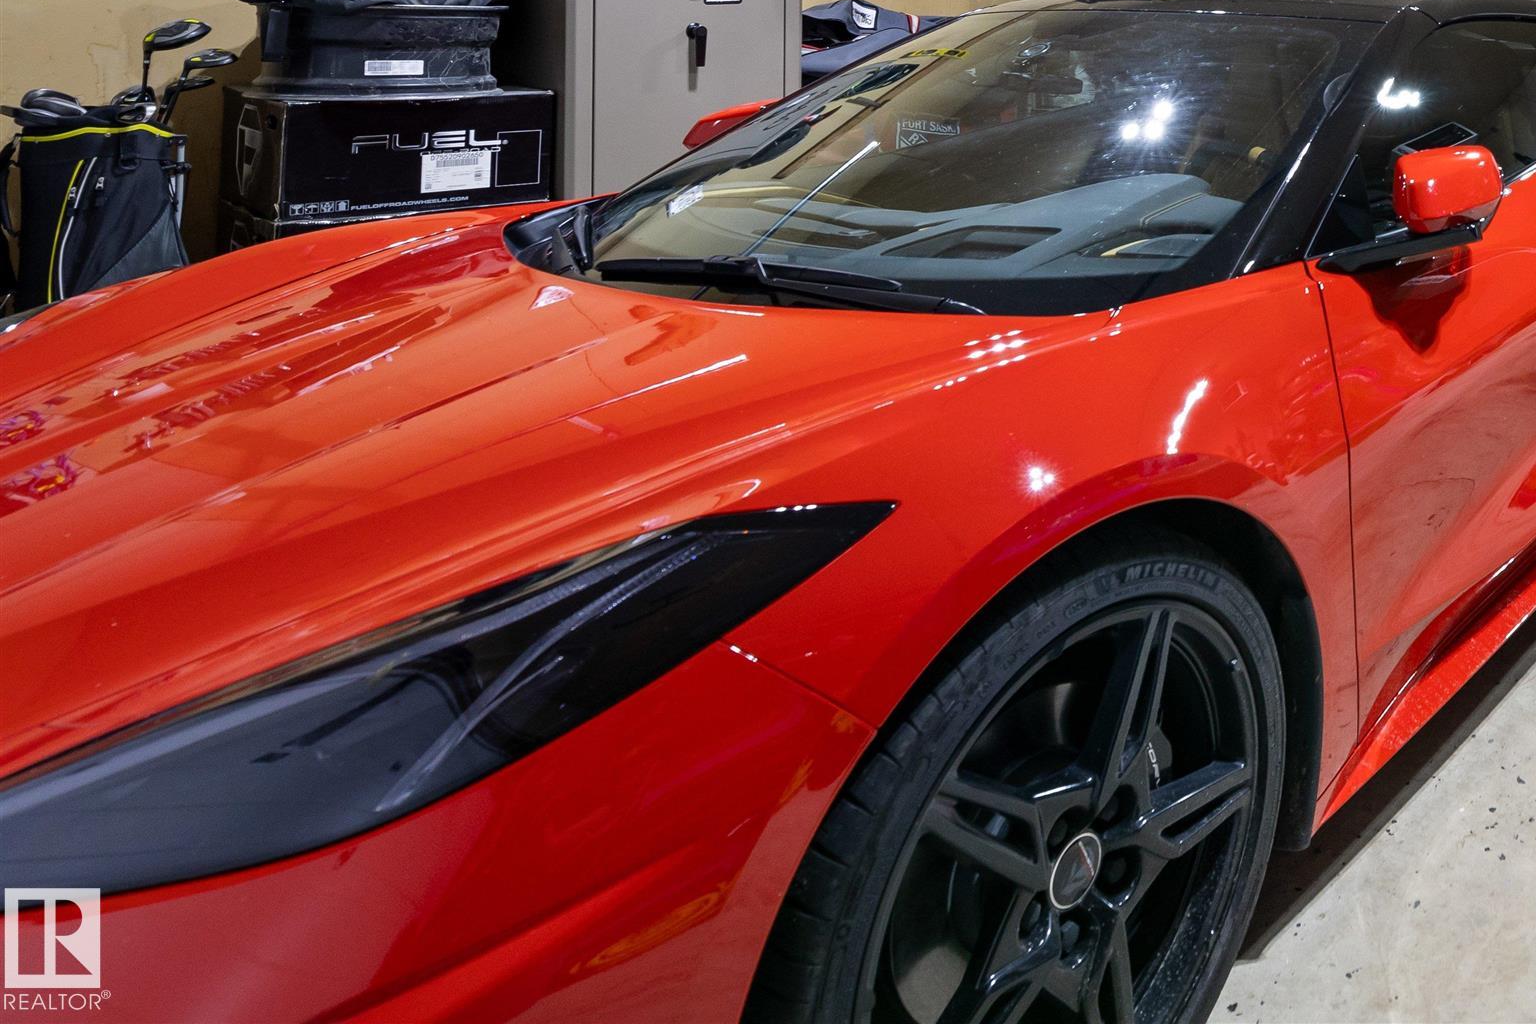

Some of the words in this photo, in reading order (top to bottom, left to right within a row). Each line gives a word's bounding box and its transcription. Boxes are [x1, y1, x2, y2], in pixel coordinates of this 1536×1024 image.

[352, 129, 502, 154] FUEL
[351, 195, 470, 211] FUELOFFROADWHEELS.COM
[1125, 562, 1216, 587] MICHELIN
